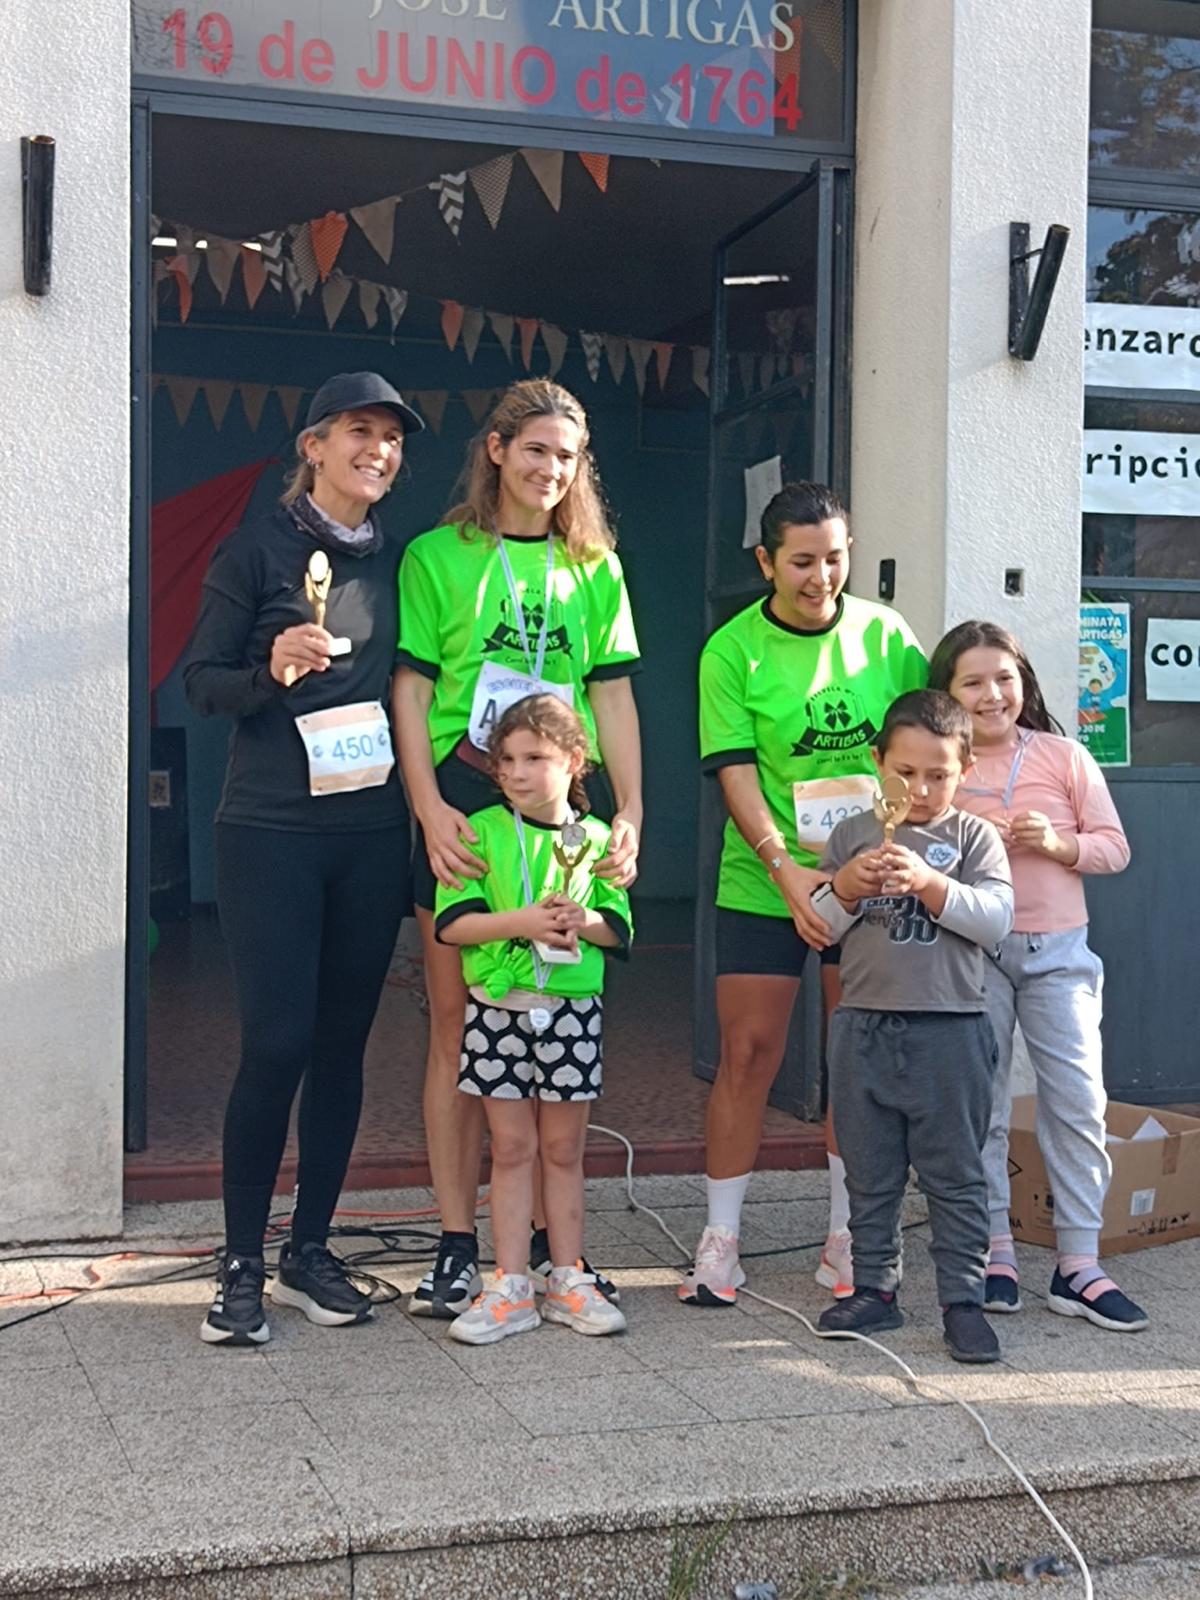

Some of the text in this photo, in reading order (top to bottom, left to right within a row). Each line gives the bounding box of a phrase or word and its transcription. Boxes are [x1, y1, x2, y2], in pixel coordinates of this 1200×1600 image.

[549, 0, 794, 51] ARTIGAS
[162, 8, 804, 132] 19 de JUNIO de 1764
[1086, 444, 1200, 484] ripci
[1150, 643, 1200, 668] co
[332, 734, 374, 761] 450
[812, 728, 867, 748] ARTIGAS
